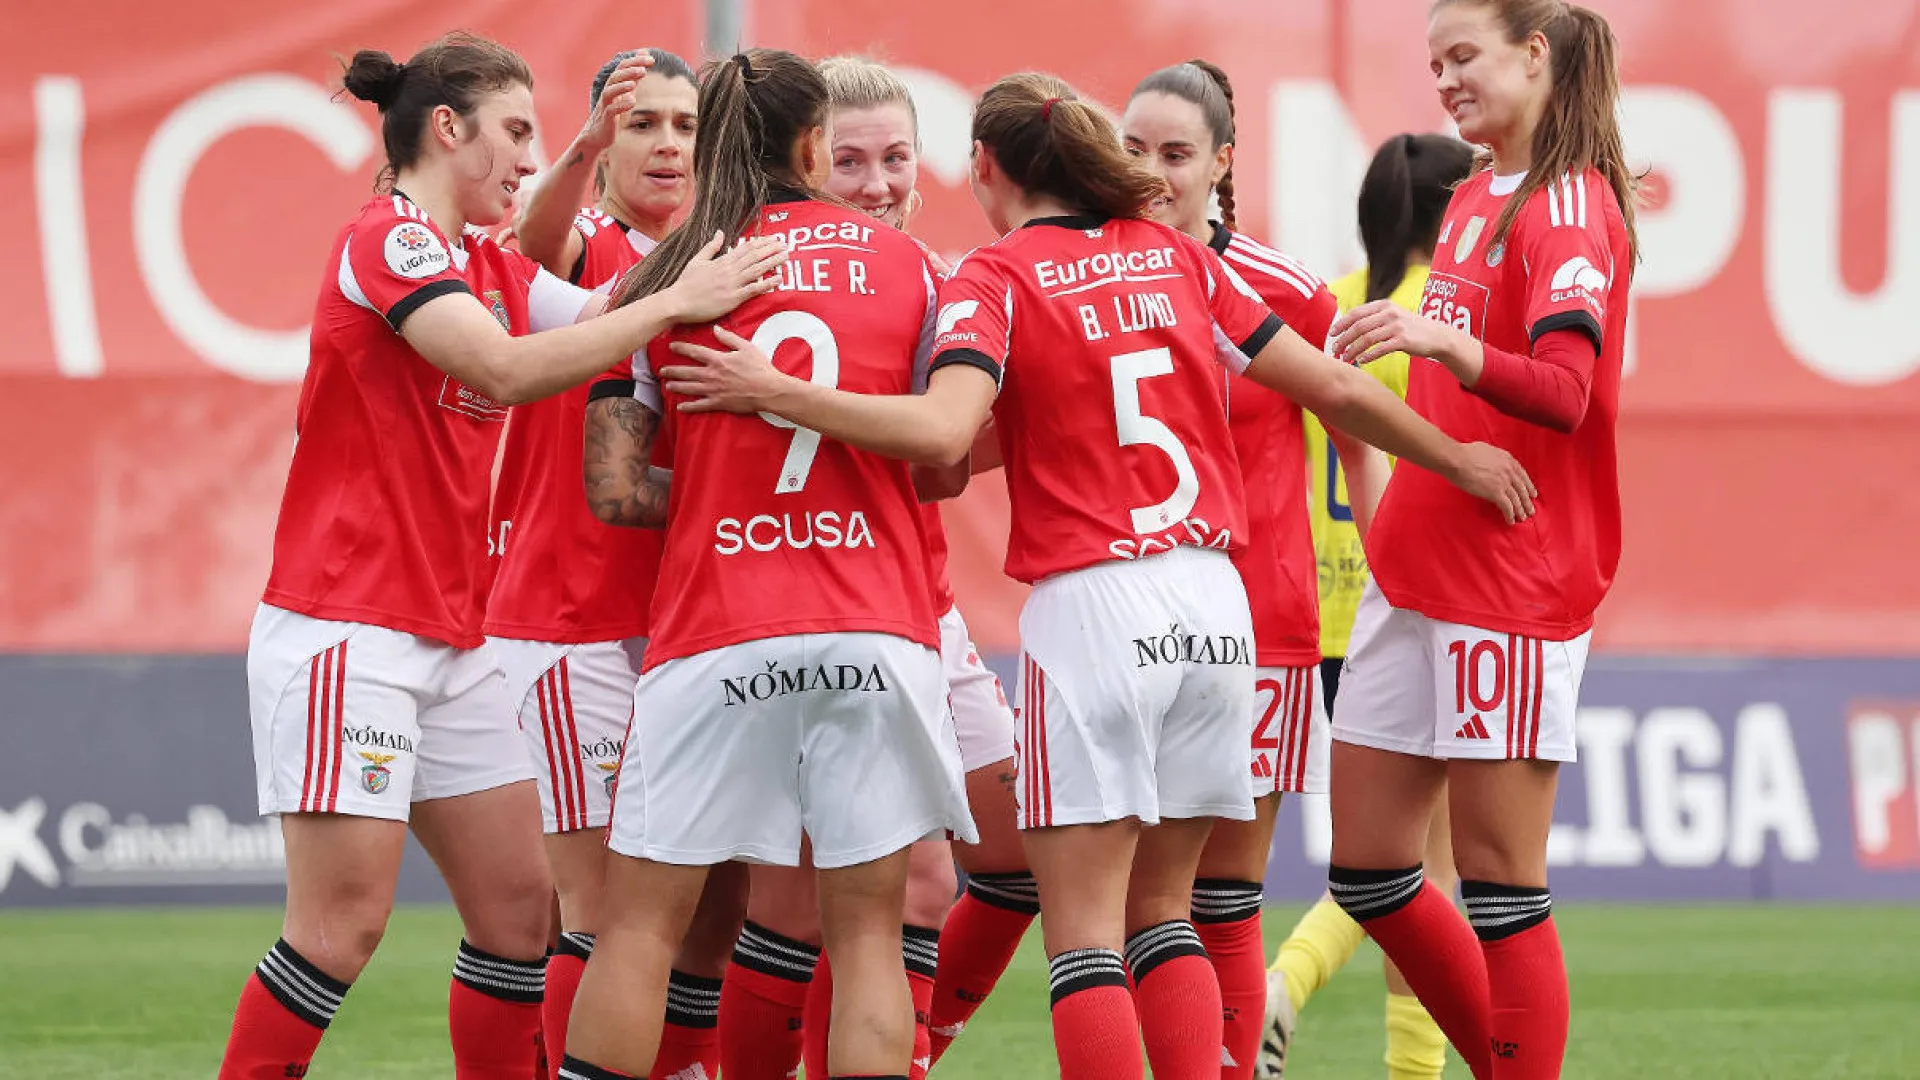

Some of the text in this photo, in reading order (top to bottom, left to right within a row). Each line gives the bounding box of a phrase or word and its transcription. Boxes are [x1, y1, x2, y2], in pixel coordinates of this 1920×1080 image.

[848, 260, 876, 295] R.
[1034, 247, 1175, 288] Europcar
[1078, 293, 1177, 341] B. LUND
[751, 310, 839, 494] 9
[1110, 346, 1199, 535] 5
[714, 511, 876, 555] SCUSA
[1448, 640, 1506, 714] 10
[1546, 702, 1820, 867] IGA
